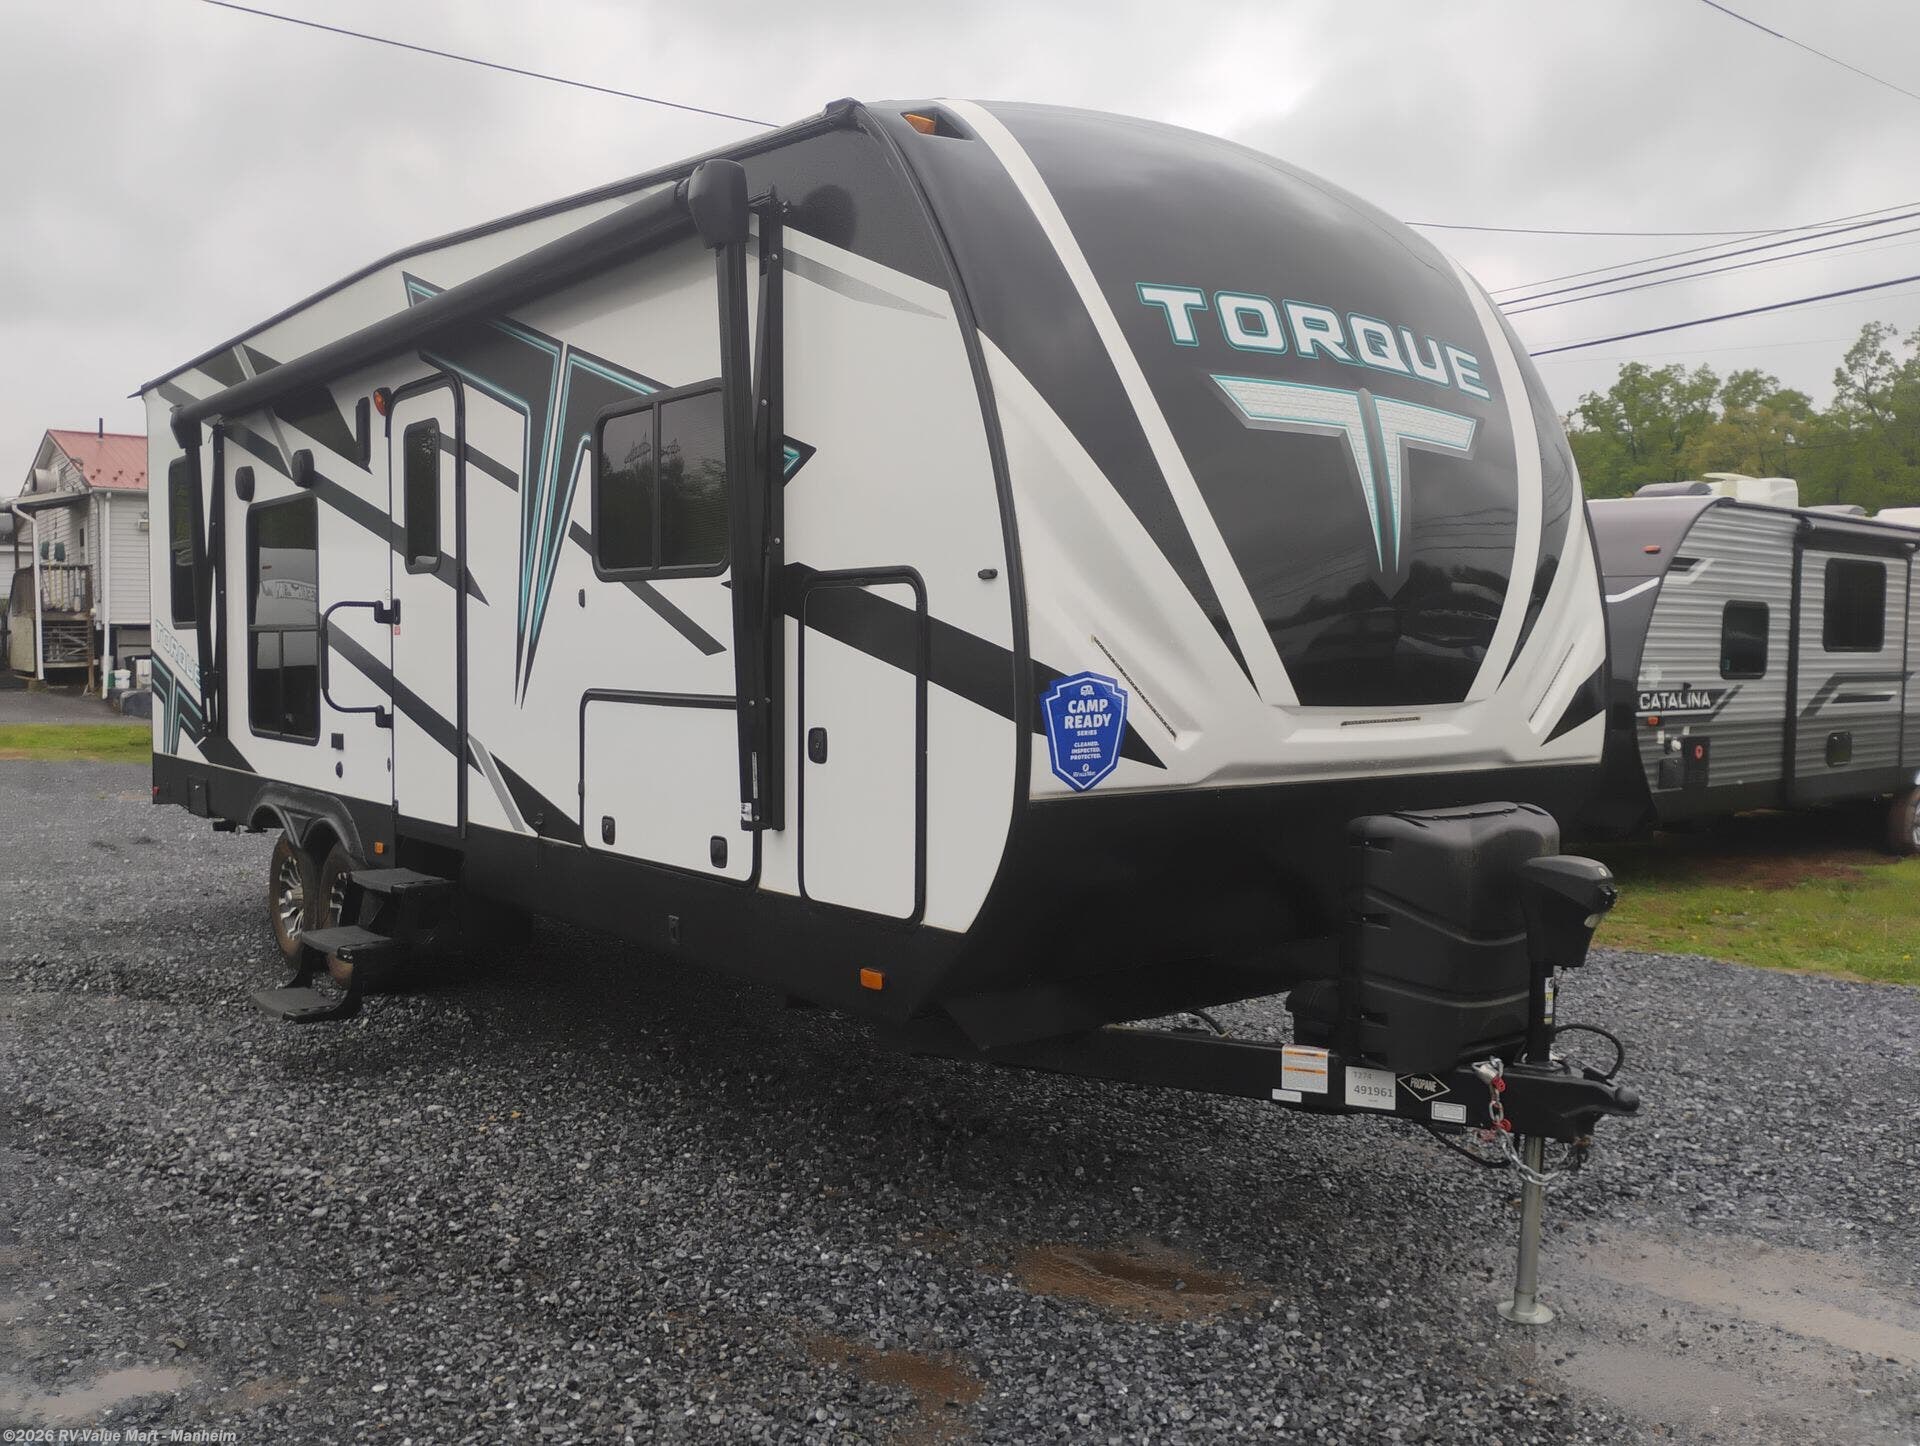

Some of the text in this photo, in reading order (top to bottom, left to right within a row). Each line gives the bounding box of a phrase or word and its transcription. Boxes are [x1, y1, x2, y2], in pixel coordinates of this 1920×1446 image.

[1135, 282, 1492, 400] TORQUE
[1068, 699, 1108, 714] CAMP
[1639, 692, 1711, 710] CATALINA
[1064, 713, 1112, 729] READY
[1353, 1085, 1394, 1098] 491961
[1410, 1077, 1437, 1092] PROPANE
